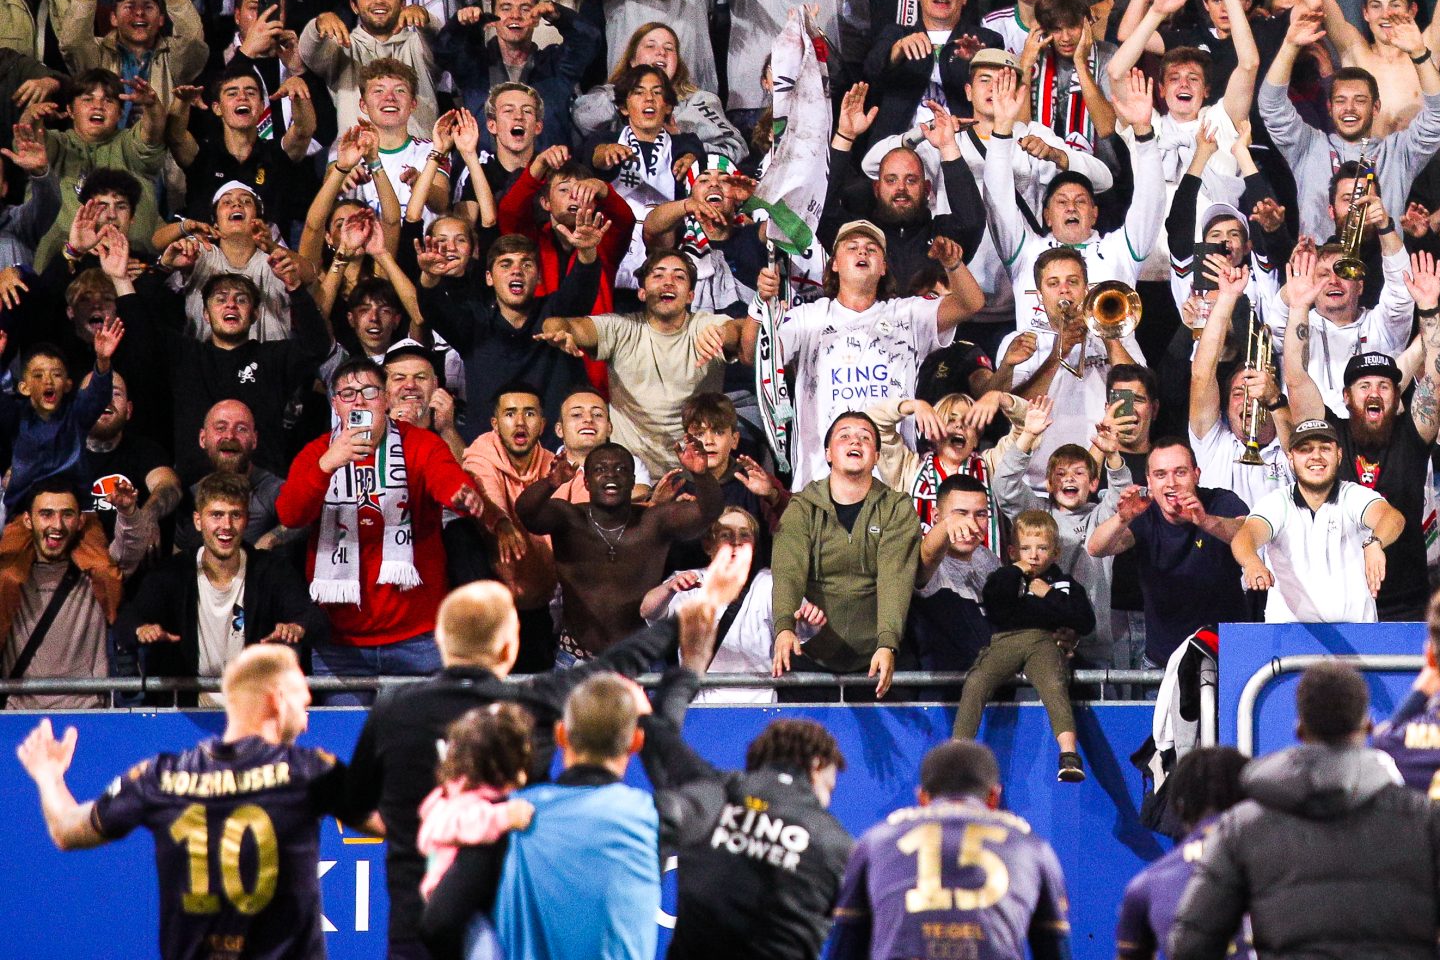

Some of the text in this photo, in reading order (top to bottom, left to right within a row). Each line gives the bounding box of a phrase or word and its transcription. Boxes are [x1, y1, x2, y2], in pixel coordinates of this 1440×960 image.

[830, 364, 889, 385] KING
[831, 384, 889, 401] POWER
[160, 761, 290, 797] HOLZHAUSER
[719, 802, 811, 853] KING
[168, 801, 279, 916] 10
[710, 829, 802, 871] POWER
[895, 821, 1010, 913] 15
